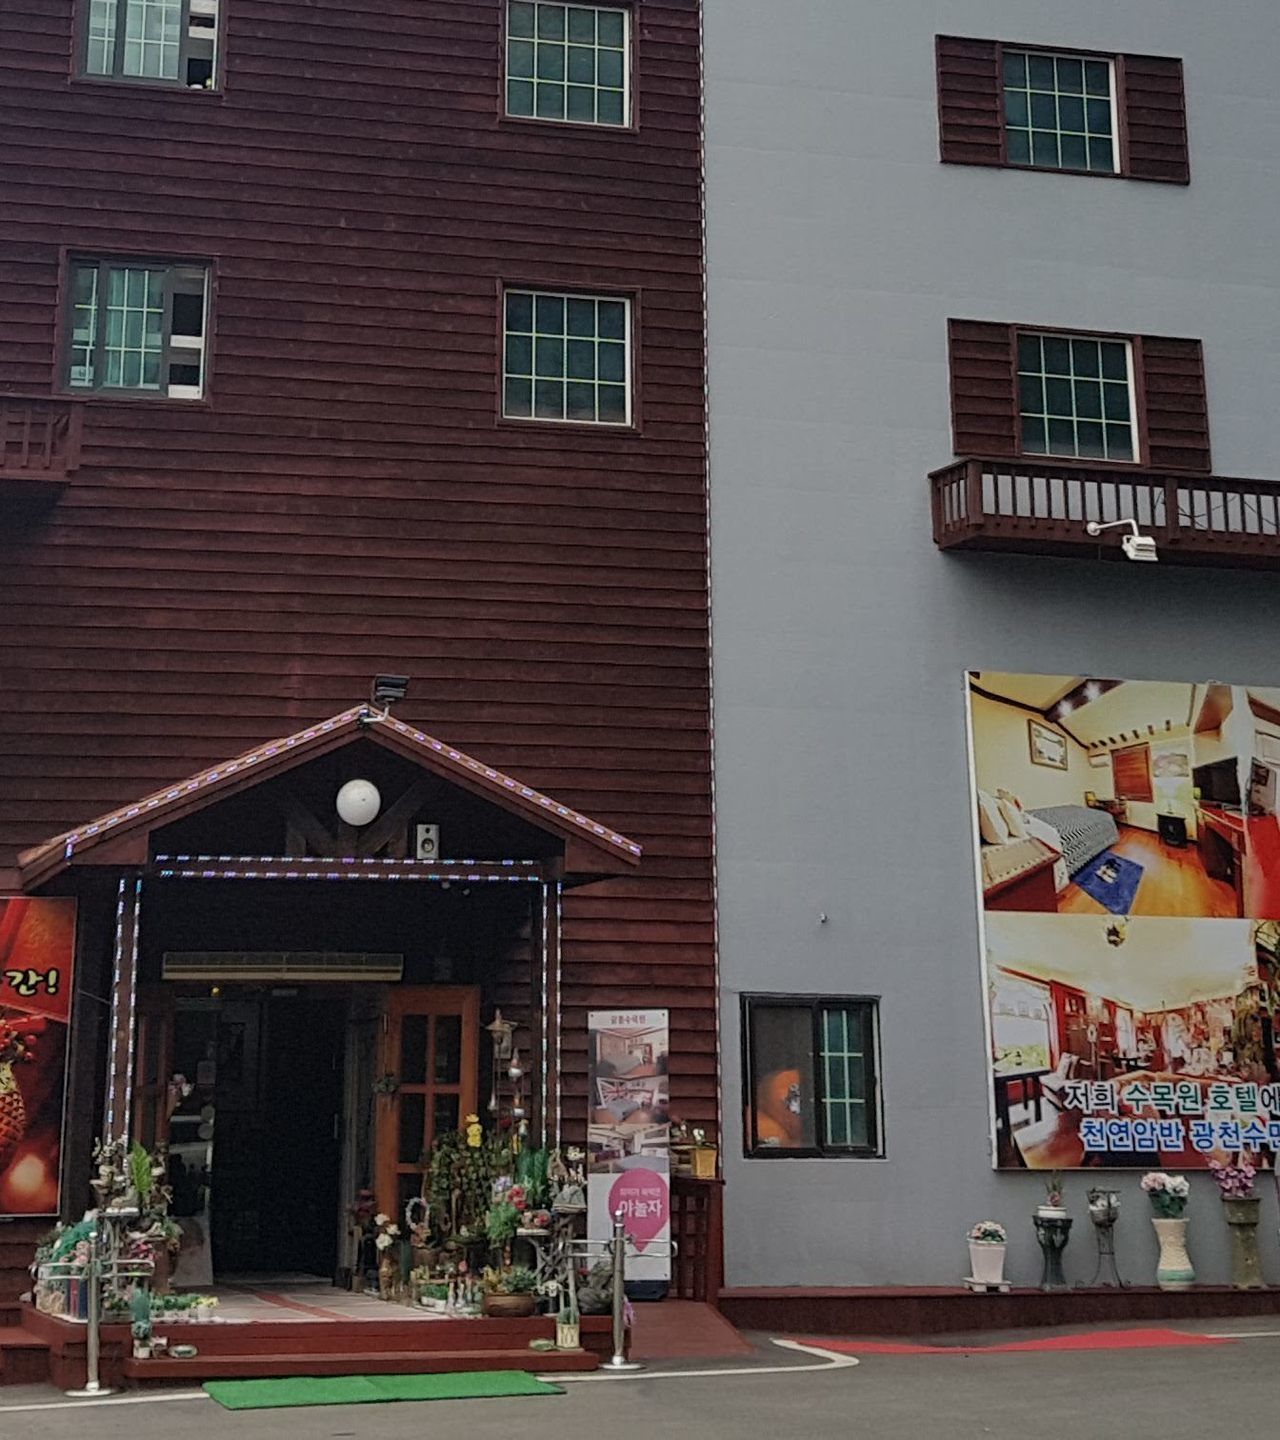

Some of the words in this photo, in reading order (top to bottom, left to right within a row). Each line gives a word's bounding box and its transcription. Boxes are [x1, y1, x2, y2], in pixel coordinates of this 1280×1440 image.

[1066, 1083, 1117, 1111] 저희
[1124, 1083, 1200, 1112] 수목원
[1081, 1120, 1183, 1150] 천연암반
[619, 1199, 663, 1218] 야놀자
